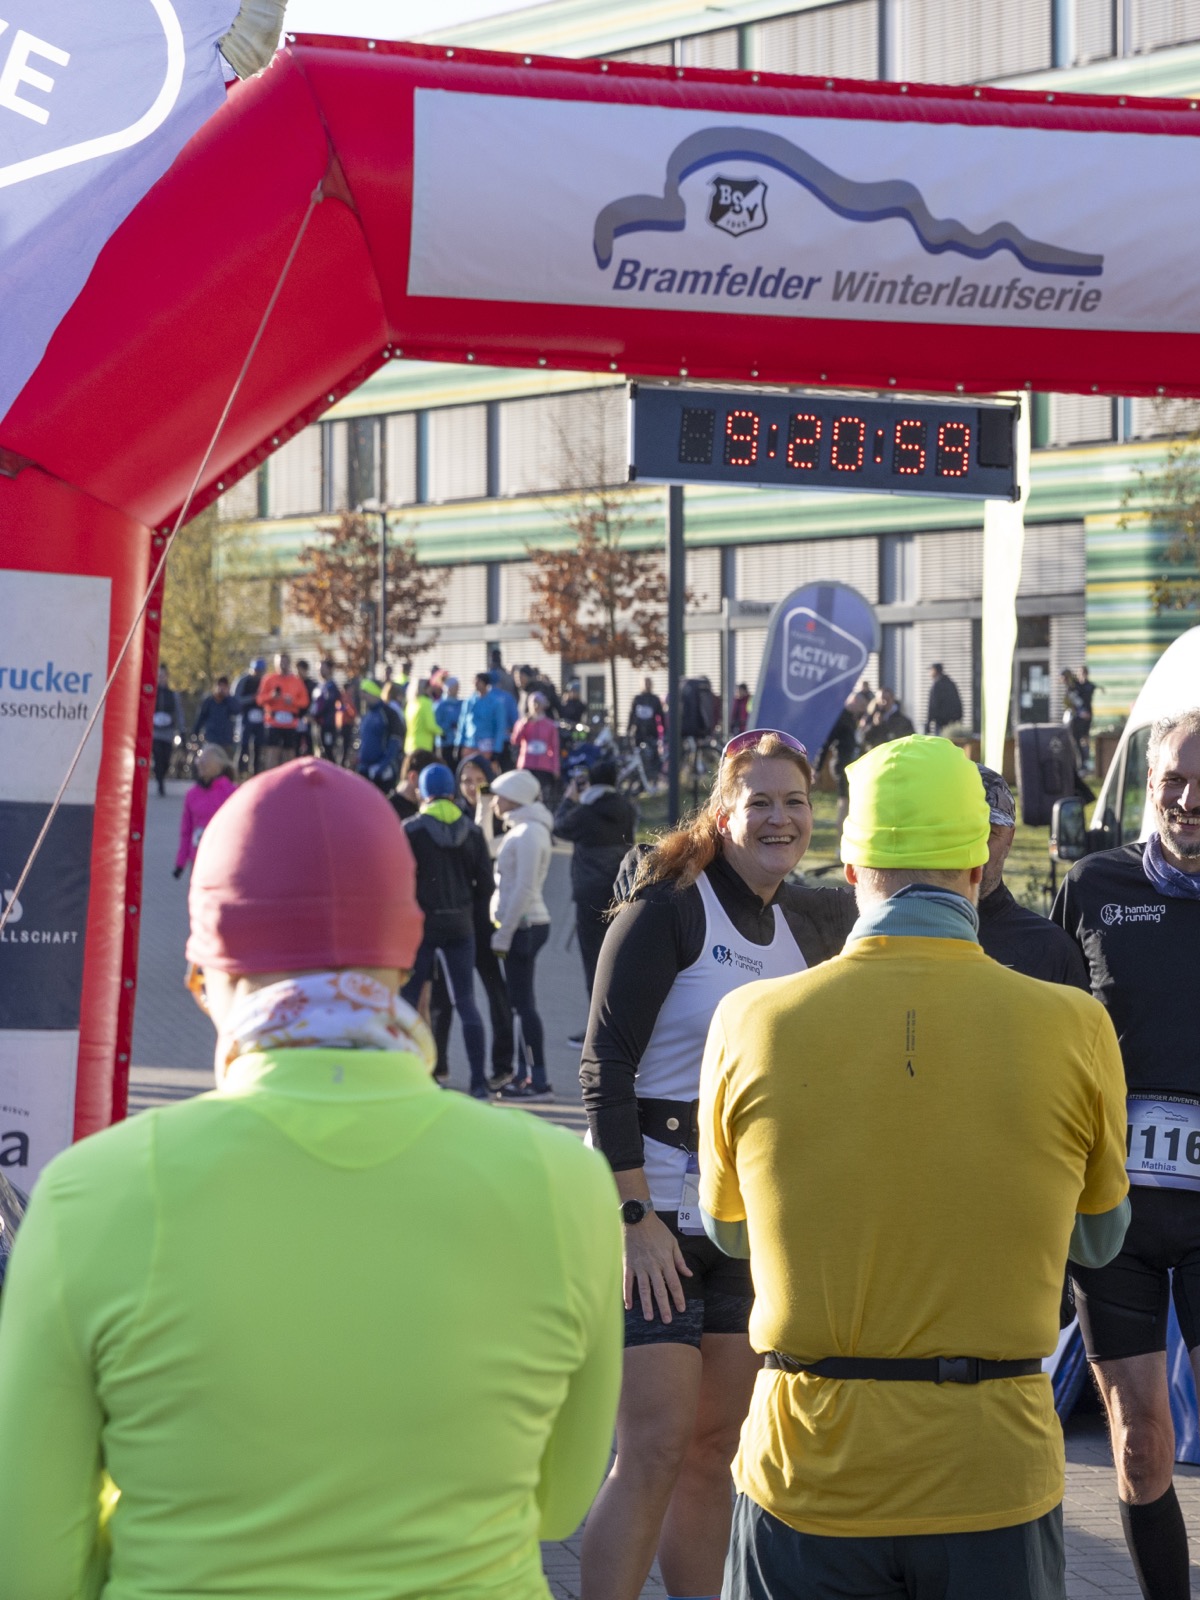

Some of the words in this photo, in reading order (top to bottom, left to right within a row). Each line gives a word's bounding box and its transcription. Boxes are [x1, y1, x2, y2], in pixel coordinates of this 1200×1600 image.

[0, 18, 71, 126] E
[612, 258, 822, 301] Bramfelder
[831, 270, 1103, 313] Winterlaufserie
[726, 410, 971, 476] 9:20:59
[789, 643, 850, 671] ACTIVE
[788, 659, 828, 682] CITY
[1124, 904, 1166, 915] hamburg
[1124, 912, 1161, 923] running
[734, 951, 764, 969] hamburg
[735, 960, 761, 976] running
[1141, 1160, 1177, 1172] Mathias
